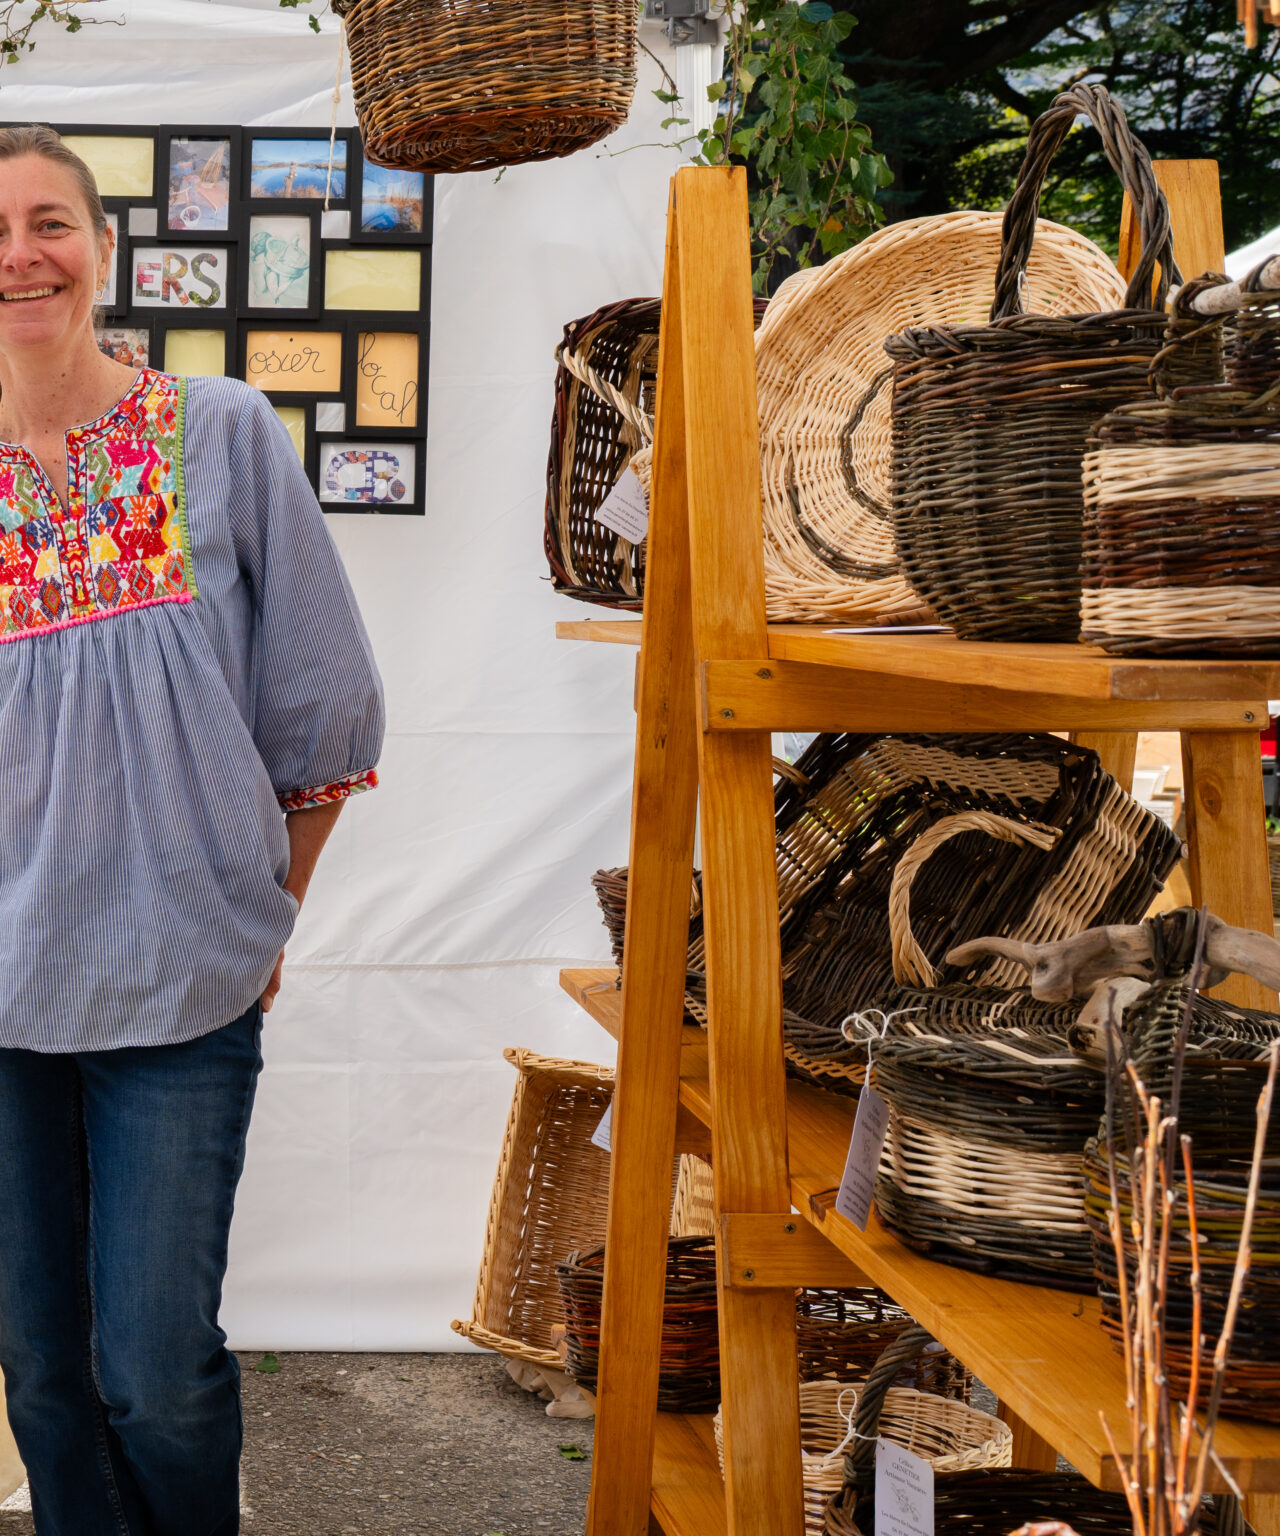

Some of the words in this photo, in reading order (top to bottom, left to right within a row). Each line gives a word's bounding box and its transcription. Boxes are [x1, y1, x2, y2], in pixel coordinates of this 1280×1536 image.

[136, 252, 220, 307] ERS
[248, 338, 326, 374] osier
[357, 332, 418, 424] local
